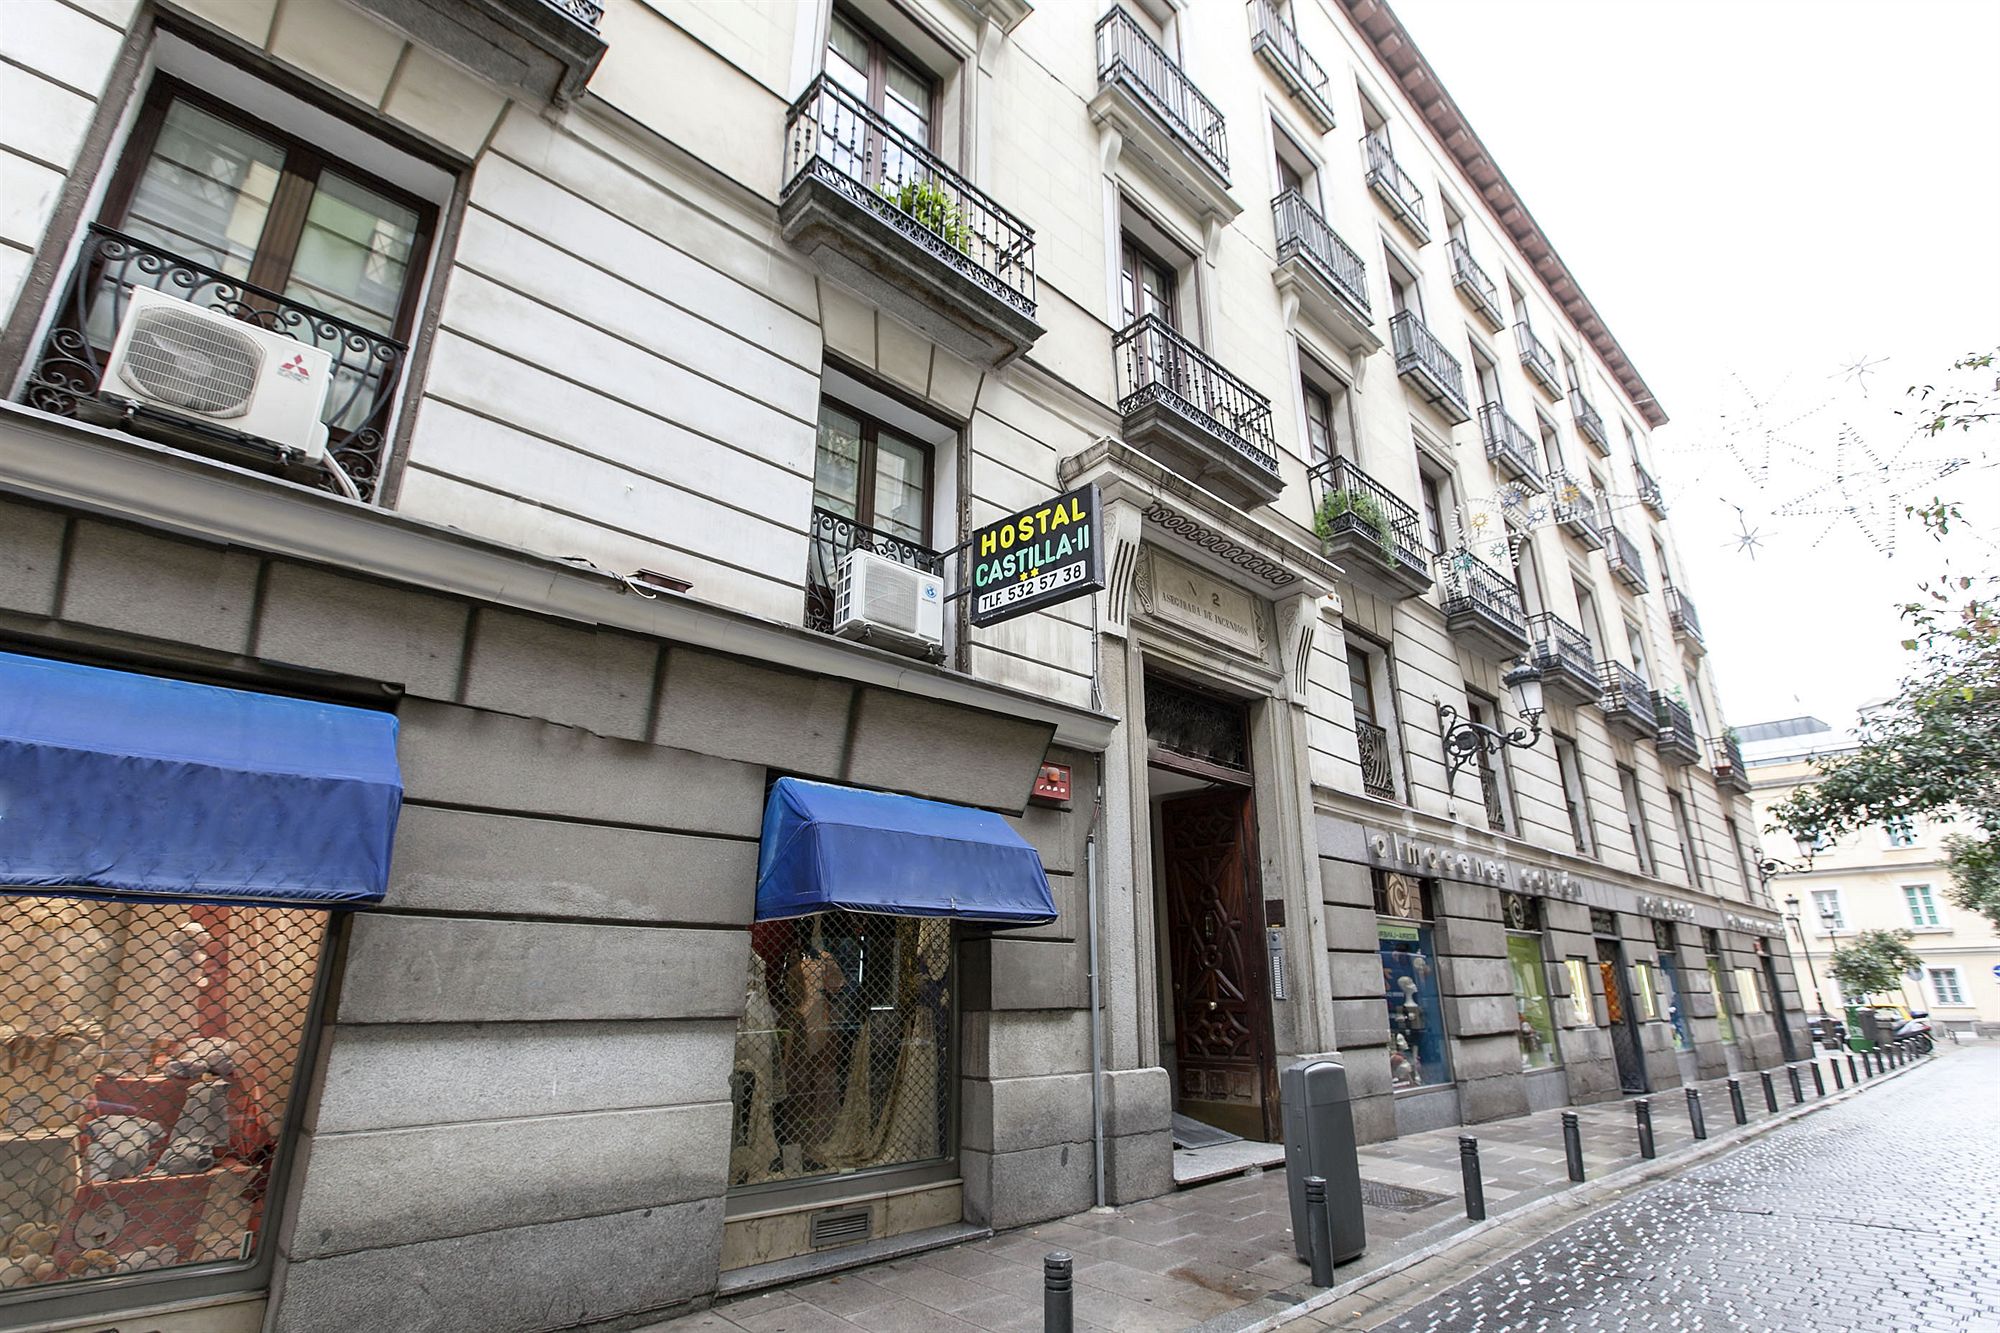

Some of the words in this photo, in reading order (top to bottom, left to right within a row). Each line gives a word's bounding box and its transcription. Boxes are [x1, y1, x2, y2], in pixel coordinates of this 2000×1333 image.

[981, 497, 1086, 557] HOSTAL
[975, 524, 1089, 587] CASTILLA-II
[982, 592, 1002, 610] TLF.
[1008, 581, 1034, 601] 532
[1039, 573, 1057, 590] 57
[1063, 564, 1082, 582] 38
[1211, 592, 1221, 607] 2
[1371, 832, 1507, 884] almacenes
